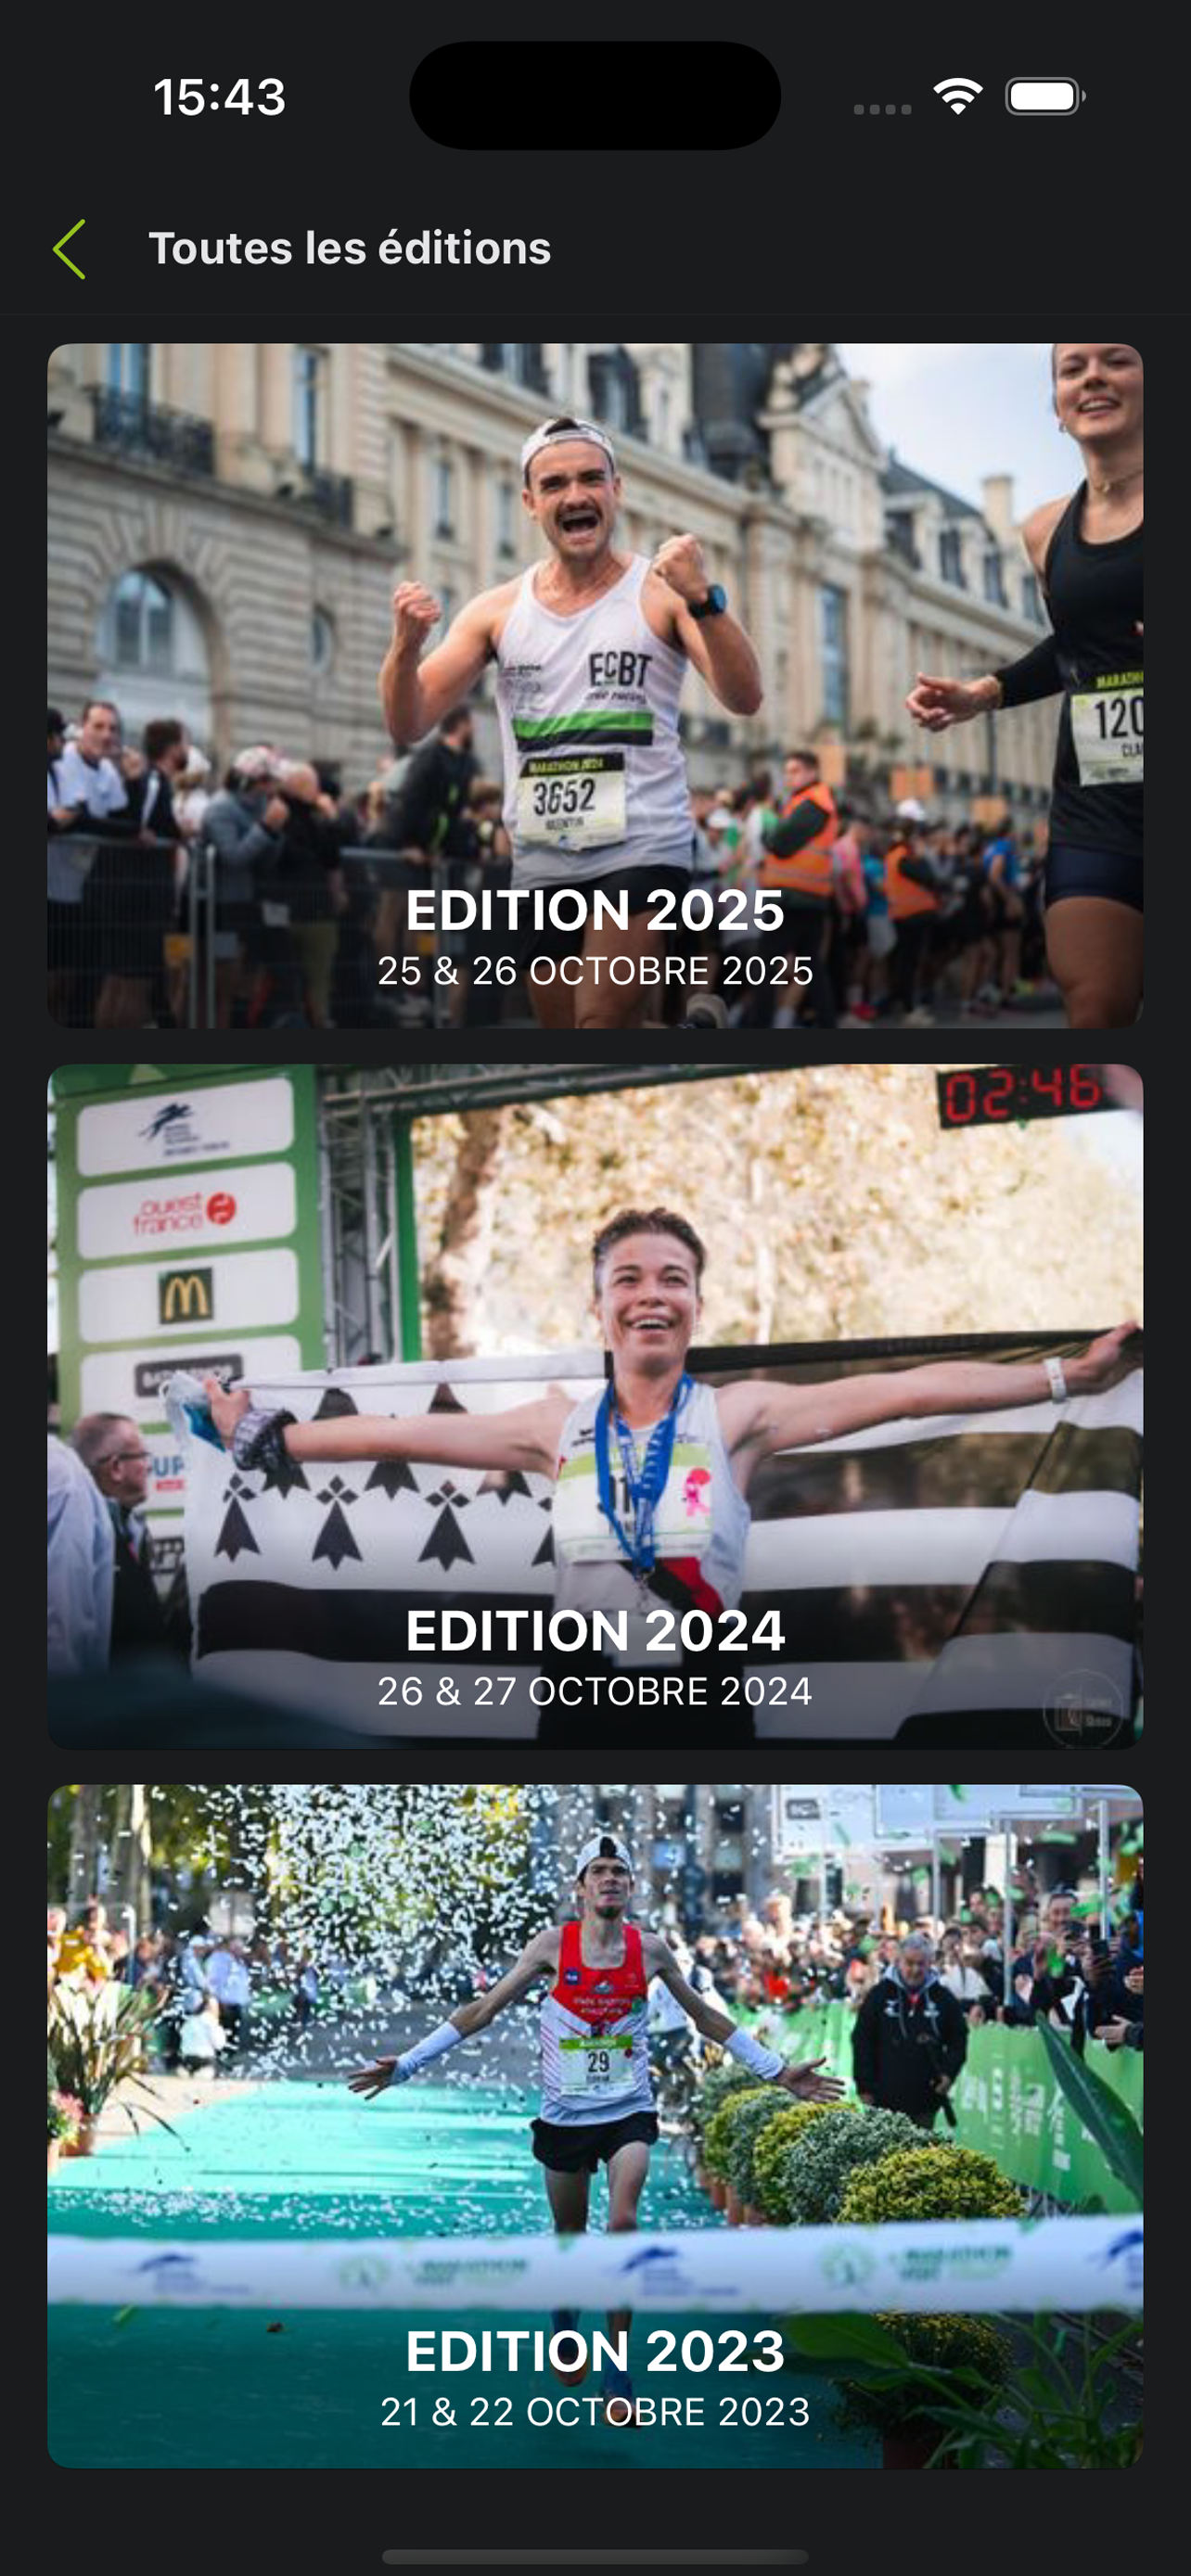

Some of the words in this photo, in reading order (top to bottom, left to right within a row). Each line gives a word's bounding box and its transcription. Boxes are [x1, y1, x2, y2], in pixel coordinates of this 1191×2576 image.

[154, 77, 286, 117] 15:43
[148, 231, 293, 265] Toutes
[306, 229, 366, 265] les
[378, 228, 552, 265] éditions
[589, 650, 653, 688] ECBT
[532, 777, 596, 816] 3652
[945, 1065, 1101, 1122] 02:46
[588, 2051, 609, 2073] 29
